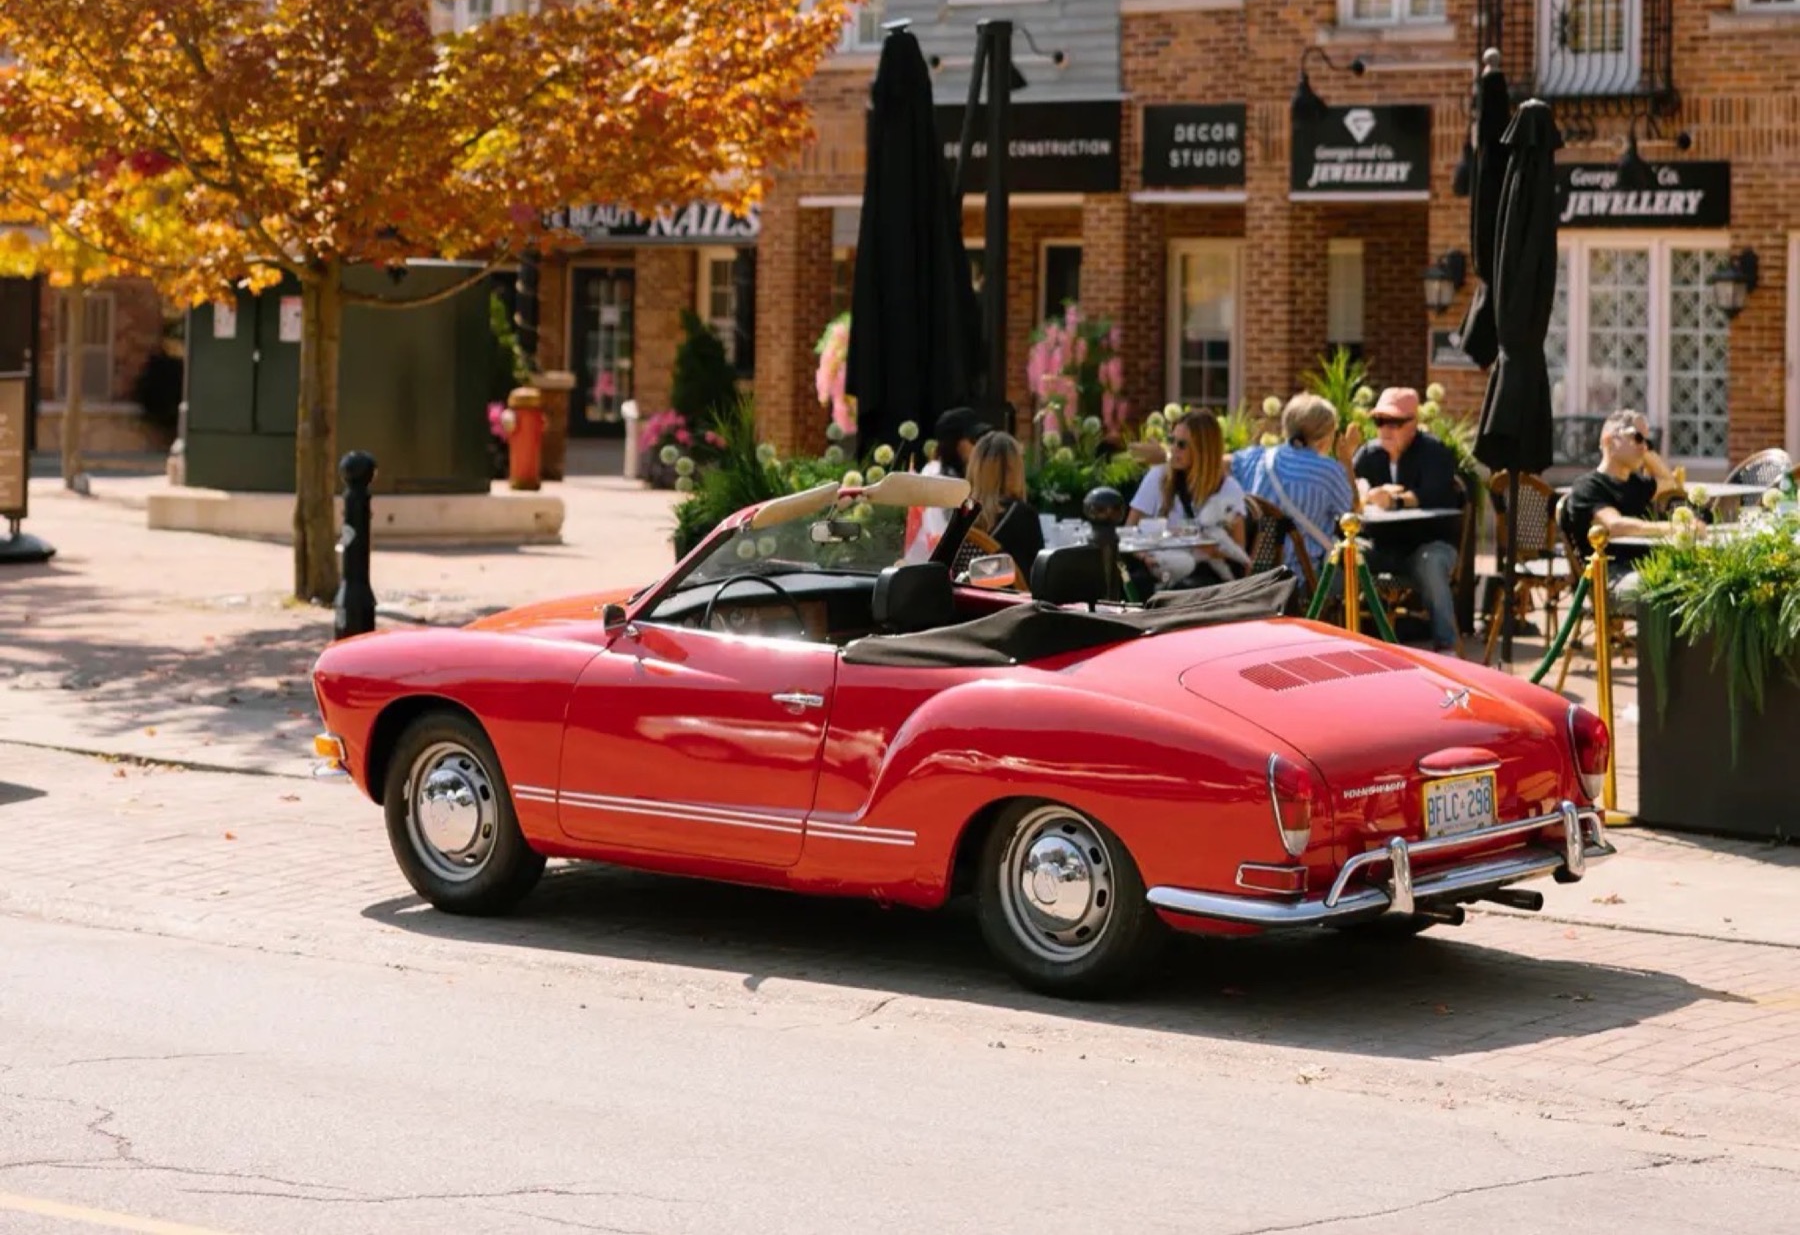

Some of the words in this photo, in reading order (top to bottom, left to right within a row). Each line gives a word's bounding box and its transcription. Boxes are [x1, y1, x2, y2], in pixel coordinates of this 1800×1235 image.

[1174, 122, 1237, 142] DECOR
[1008, 138, 1112, 158] CONSTRUCTION
[1168, 148, 1241, 168] STUDIO
[1307, 161, 1411, 188] JEWELLERY
[1560, 188, 1704, 222] JEWELLERY
[1427, 792, 1460, 826] BFLC
[1467, 787, 1491, 819] 298
